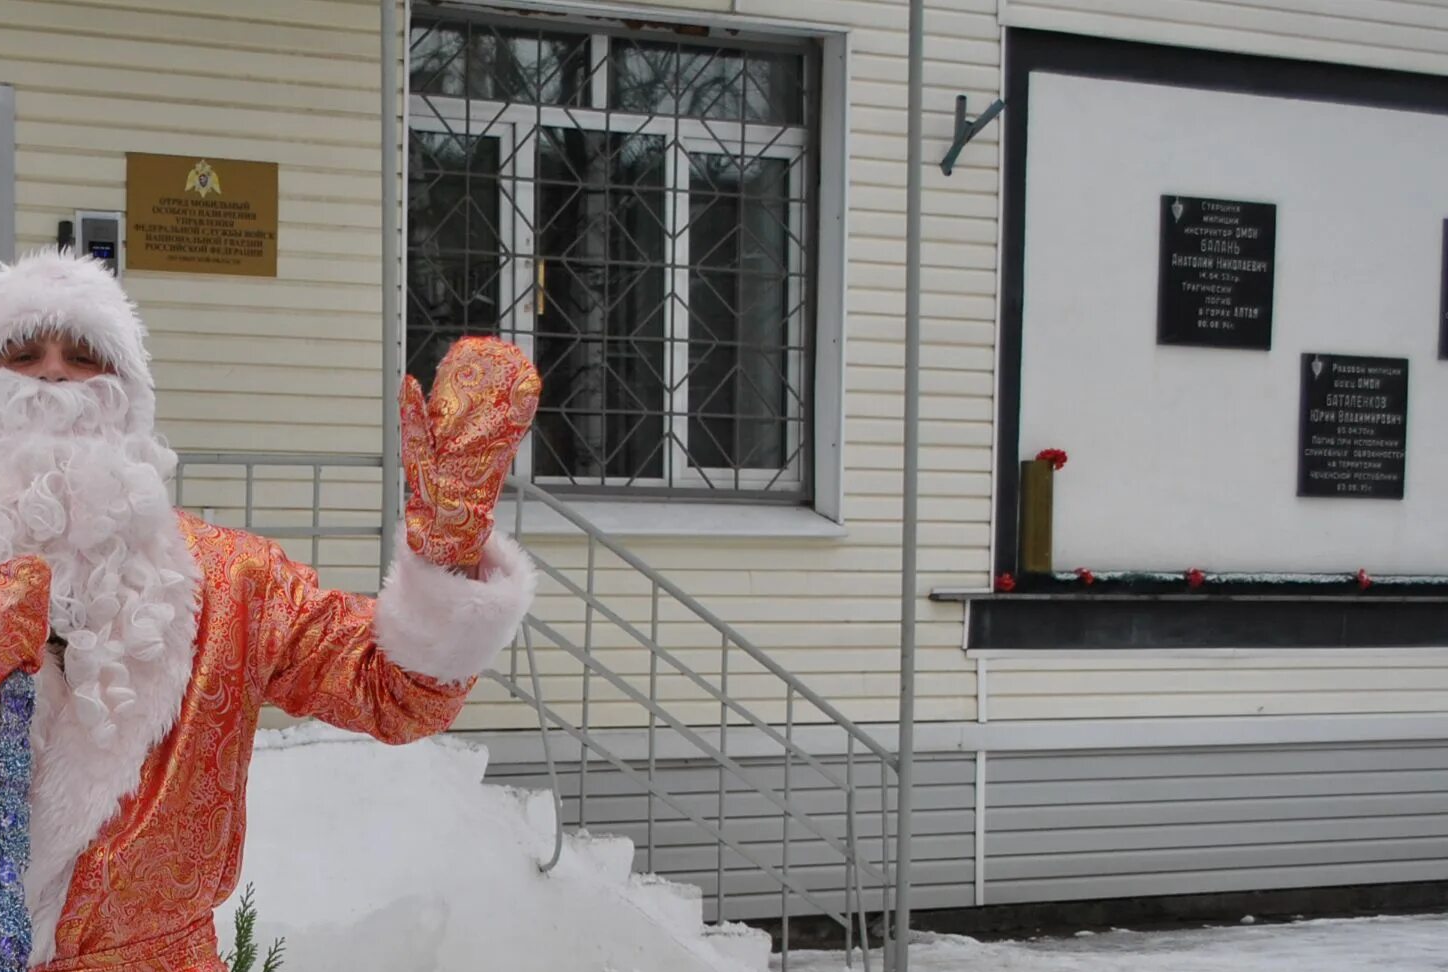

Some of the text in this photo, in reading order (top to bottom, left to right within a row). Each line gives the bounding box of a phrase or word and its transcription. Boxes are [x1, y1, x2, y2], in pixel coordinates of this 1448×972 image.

[134, 223, 200, 236] ФЕДЕРАЛЬНОЙ
[1235, 227, 1258, 239] ОМОН
[144, 242, 208, 254] РОССИЙСКОЙ
[1201, 239, 1241, 255] БАЛАНЬ
[1357, 377, 1381, 390] ОМОН
[1326, 393, 1387, 409] БАТАЛЕНКОВ
